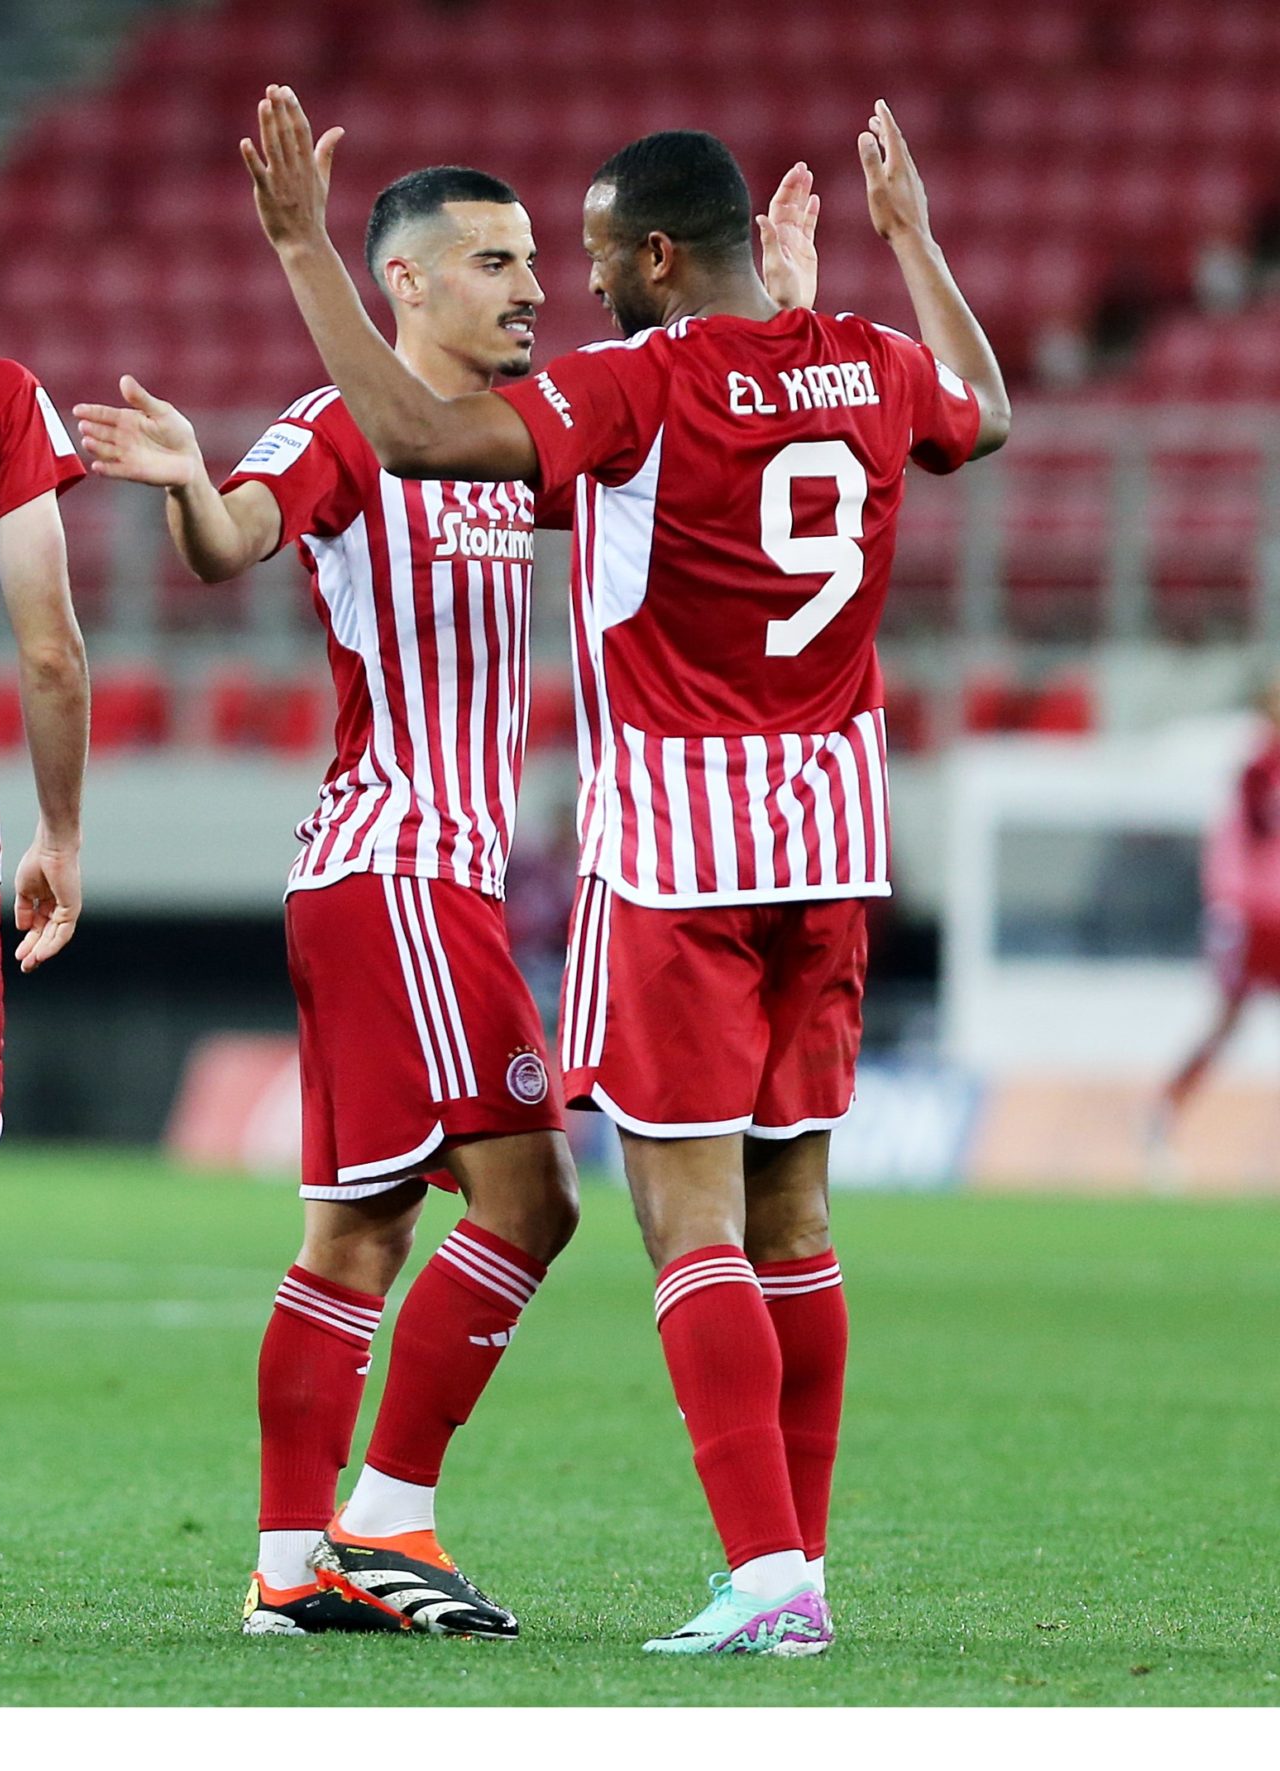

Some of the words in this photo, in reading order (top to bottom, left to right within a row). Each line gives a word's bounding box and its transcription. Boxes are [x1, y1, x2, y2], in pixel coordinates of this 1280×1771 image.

[727, 370, 777, 415] EL
[777, 360, 880, 413] KAABI
[760, 439, 869, 657] 9
